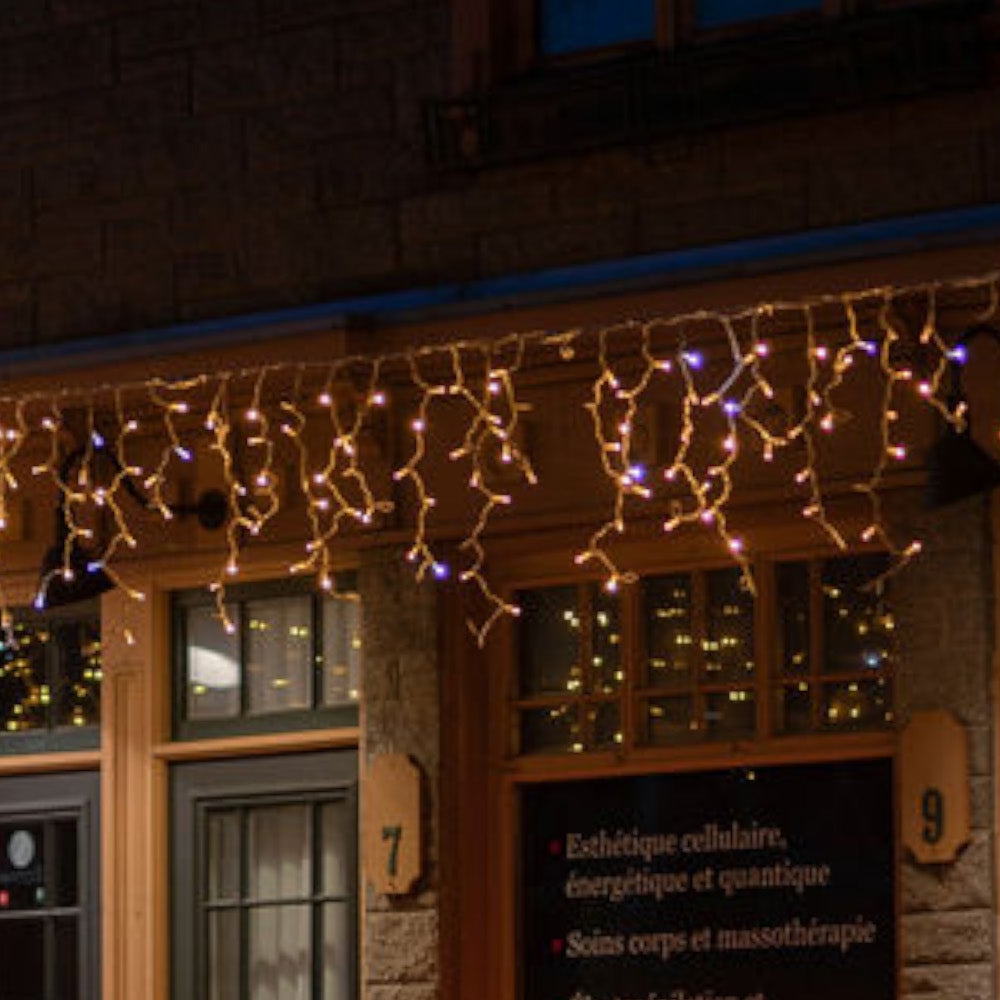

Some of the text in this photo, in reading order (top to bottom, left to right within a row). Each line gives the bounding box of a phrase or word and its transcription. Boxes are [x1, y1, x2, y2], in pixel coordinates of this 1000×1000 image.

[922, 787, 944, 844] 9
[382, 826, 402, 877] 7
[692, 868, 714, 890] et
[718, 859, 831, 896] quantique
[566, 928, 624, 958] Soins
[629, 932, 688, 961] corps
[692, 926, 711, 950] et
